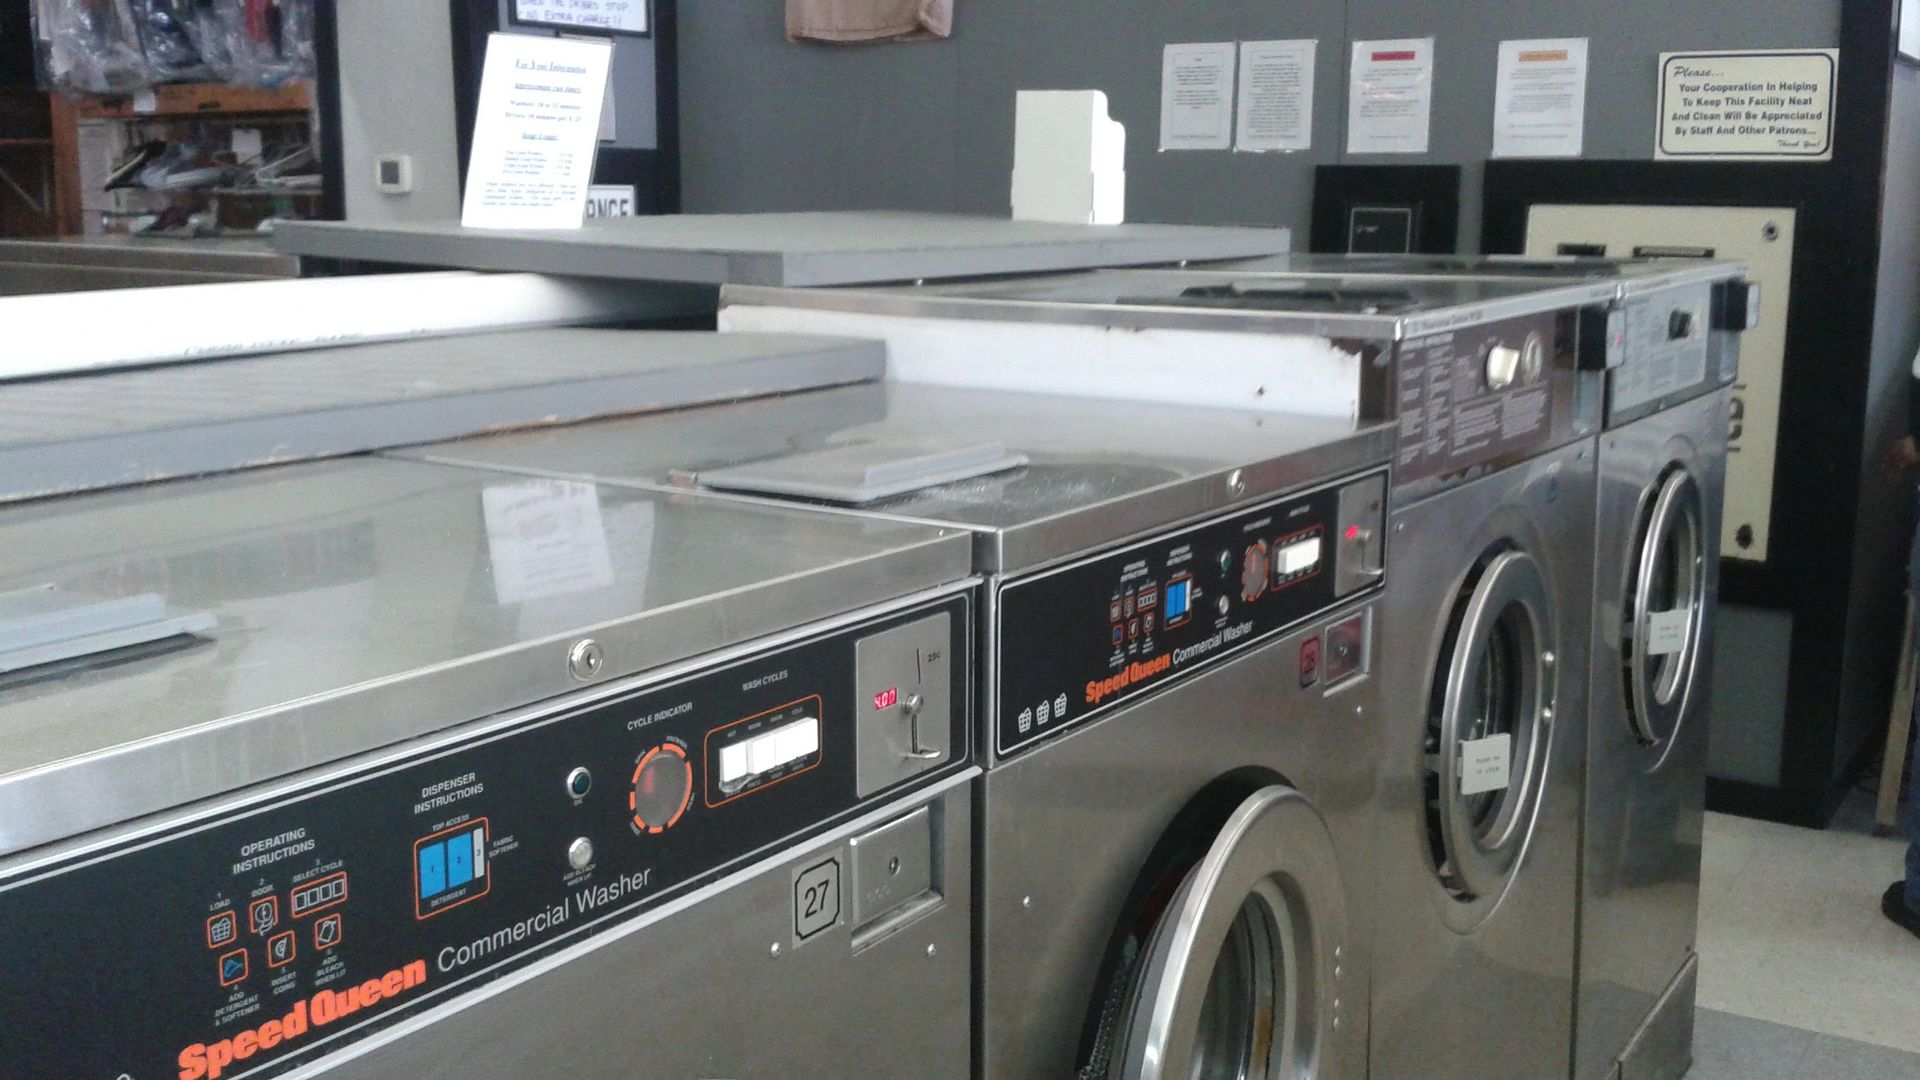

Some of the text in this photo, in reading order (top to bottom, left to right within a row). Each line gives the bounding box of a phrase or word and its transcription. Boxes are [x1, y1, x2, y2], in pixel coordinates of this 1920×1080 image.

[1679, 81, 1818, 94] Your Cooperation In Helping
[1683, 96, 1812, 108] To Keep This Facility Neat
[1671, 111, 1823, 122] And Clean Will Be Appreciated
[1675, 125, 1817, 137] By Staff And Other Patrons...
[1086, 665, 1130, 704] Speed
[1130, 652, 1171, 682] Queen
[1173, 633, 1222, 665] Commercial
[1223, 620, 1254, 642] Washer
[742, 669, 789, 692] WASH CYCLES
[627, 702, 694, 731] CYCLE INDICATOR
[421, 772, 476, 799] DISPENSER
[414, 783, 484, 814] INSTRUCTIONS
[432, 814, 470, 832] TOP ACCESS
[241, 827, 306, 857] OPERATING
[233, 839, 316, 875] INSTRUCTIONS
[292, 859, 344, 883] SELECT CYCLE
[251, 884, 274, 898] DOOR
[430, 888, 467, 908] DETERGENT
[804, 878, 830, 918] 27
[210, 898, 231, 911] LOAD
[316, 961, 344, 977] BLEACH
[322, 955, 338, 966] ADD
[178, 867, 652, 1080] Speed Queen Commercial Washer
[271, 971, 297, 987] INSERT
[315, 972, 336, 986] WHEN
[228, 991, 245, 1002] ADD
[273, 982, 295, 995] COINS
[215, 994, 258, 1017] DETERGENT
[222, 1003, 261, 1024] SOFTENER
